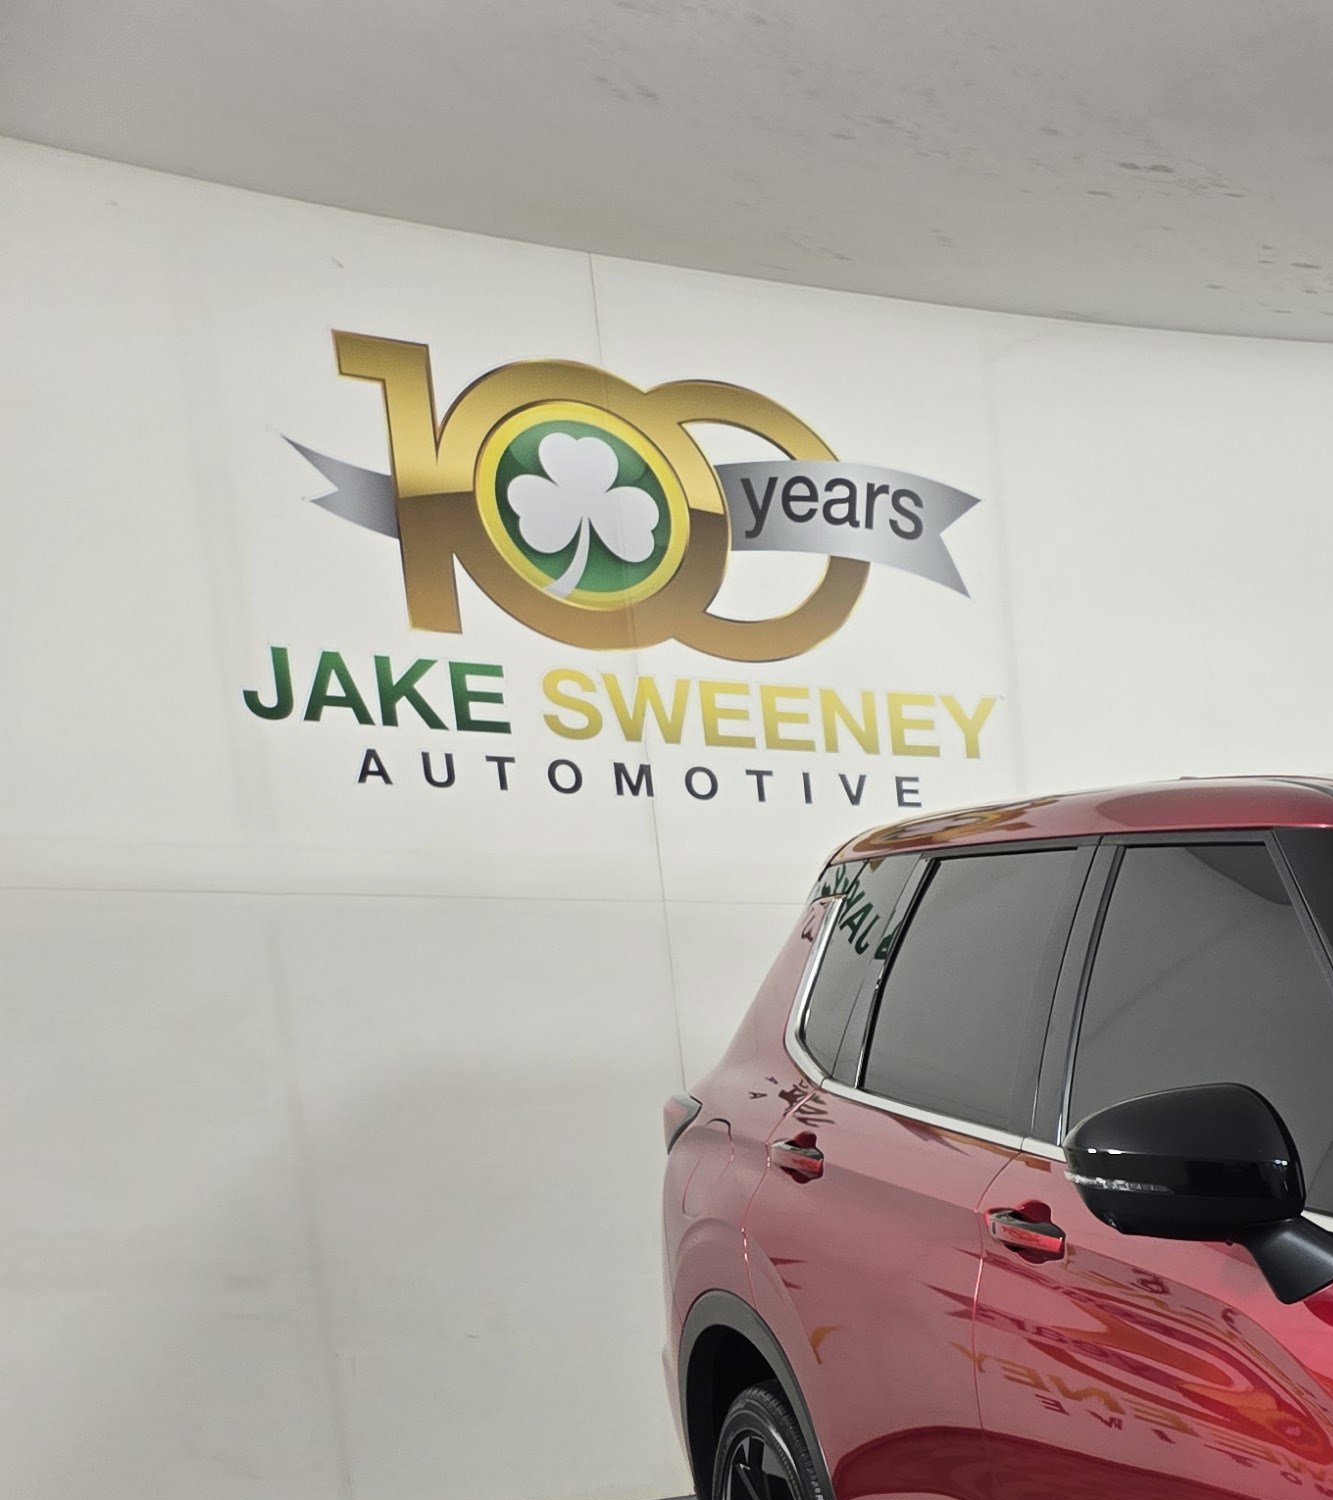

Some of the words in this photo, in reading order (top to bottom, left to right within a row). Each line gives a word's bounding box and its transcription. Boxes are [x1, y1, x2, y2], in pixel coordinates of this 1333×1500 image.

[331, 327, 872, 663] 100
[739, 473, 926, 541] years
[243, 646, 512, 735] JAKE
[541, 668, 998, 761] SWEENEY
[357, 748, 923, 808] AUTOMOTIVE
